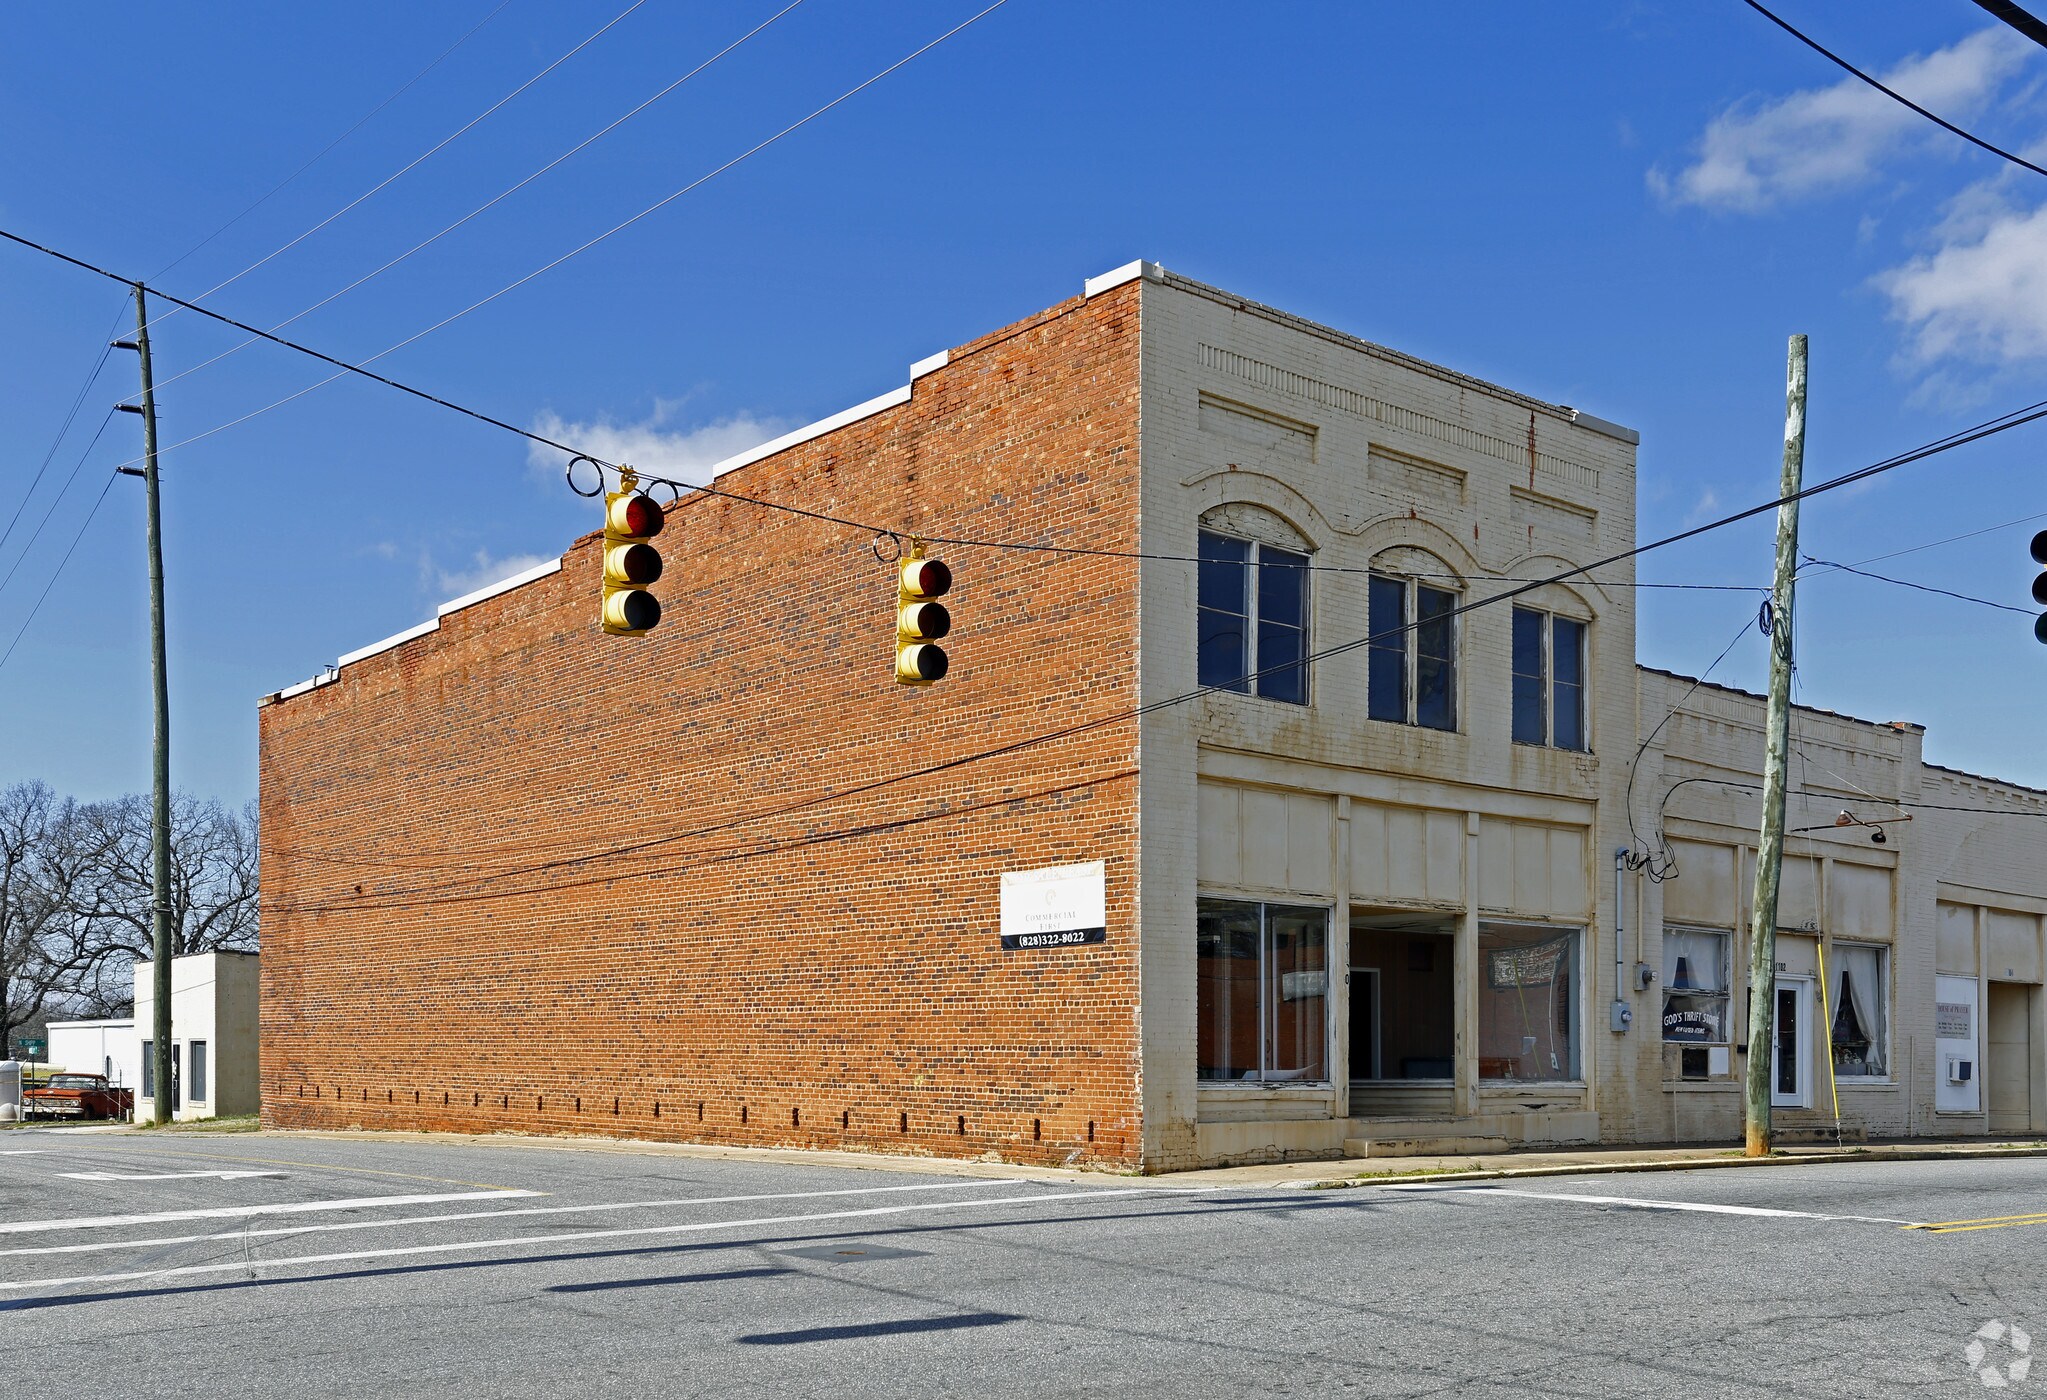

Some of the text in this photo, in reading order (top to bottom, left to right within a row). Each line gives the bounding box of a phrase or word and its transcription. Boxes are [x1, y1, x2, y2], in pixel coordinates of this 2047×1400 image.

[1025, 911, 1076, 922] COMMERCIAL
[1040, 923, 1060, 931] FIRST
[1019, 932, 1085, 947] (828)322-8022
[1664, 1012, 1682, 1026] GOD'S
[1684, 1011, 1702, 1021] THRIFT
